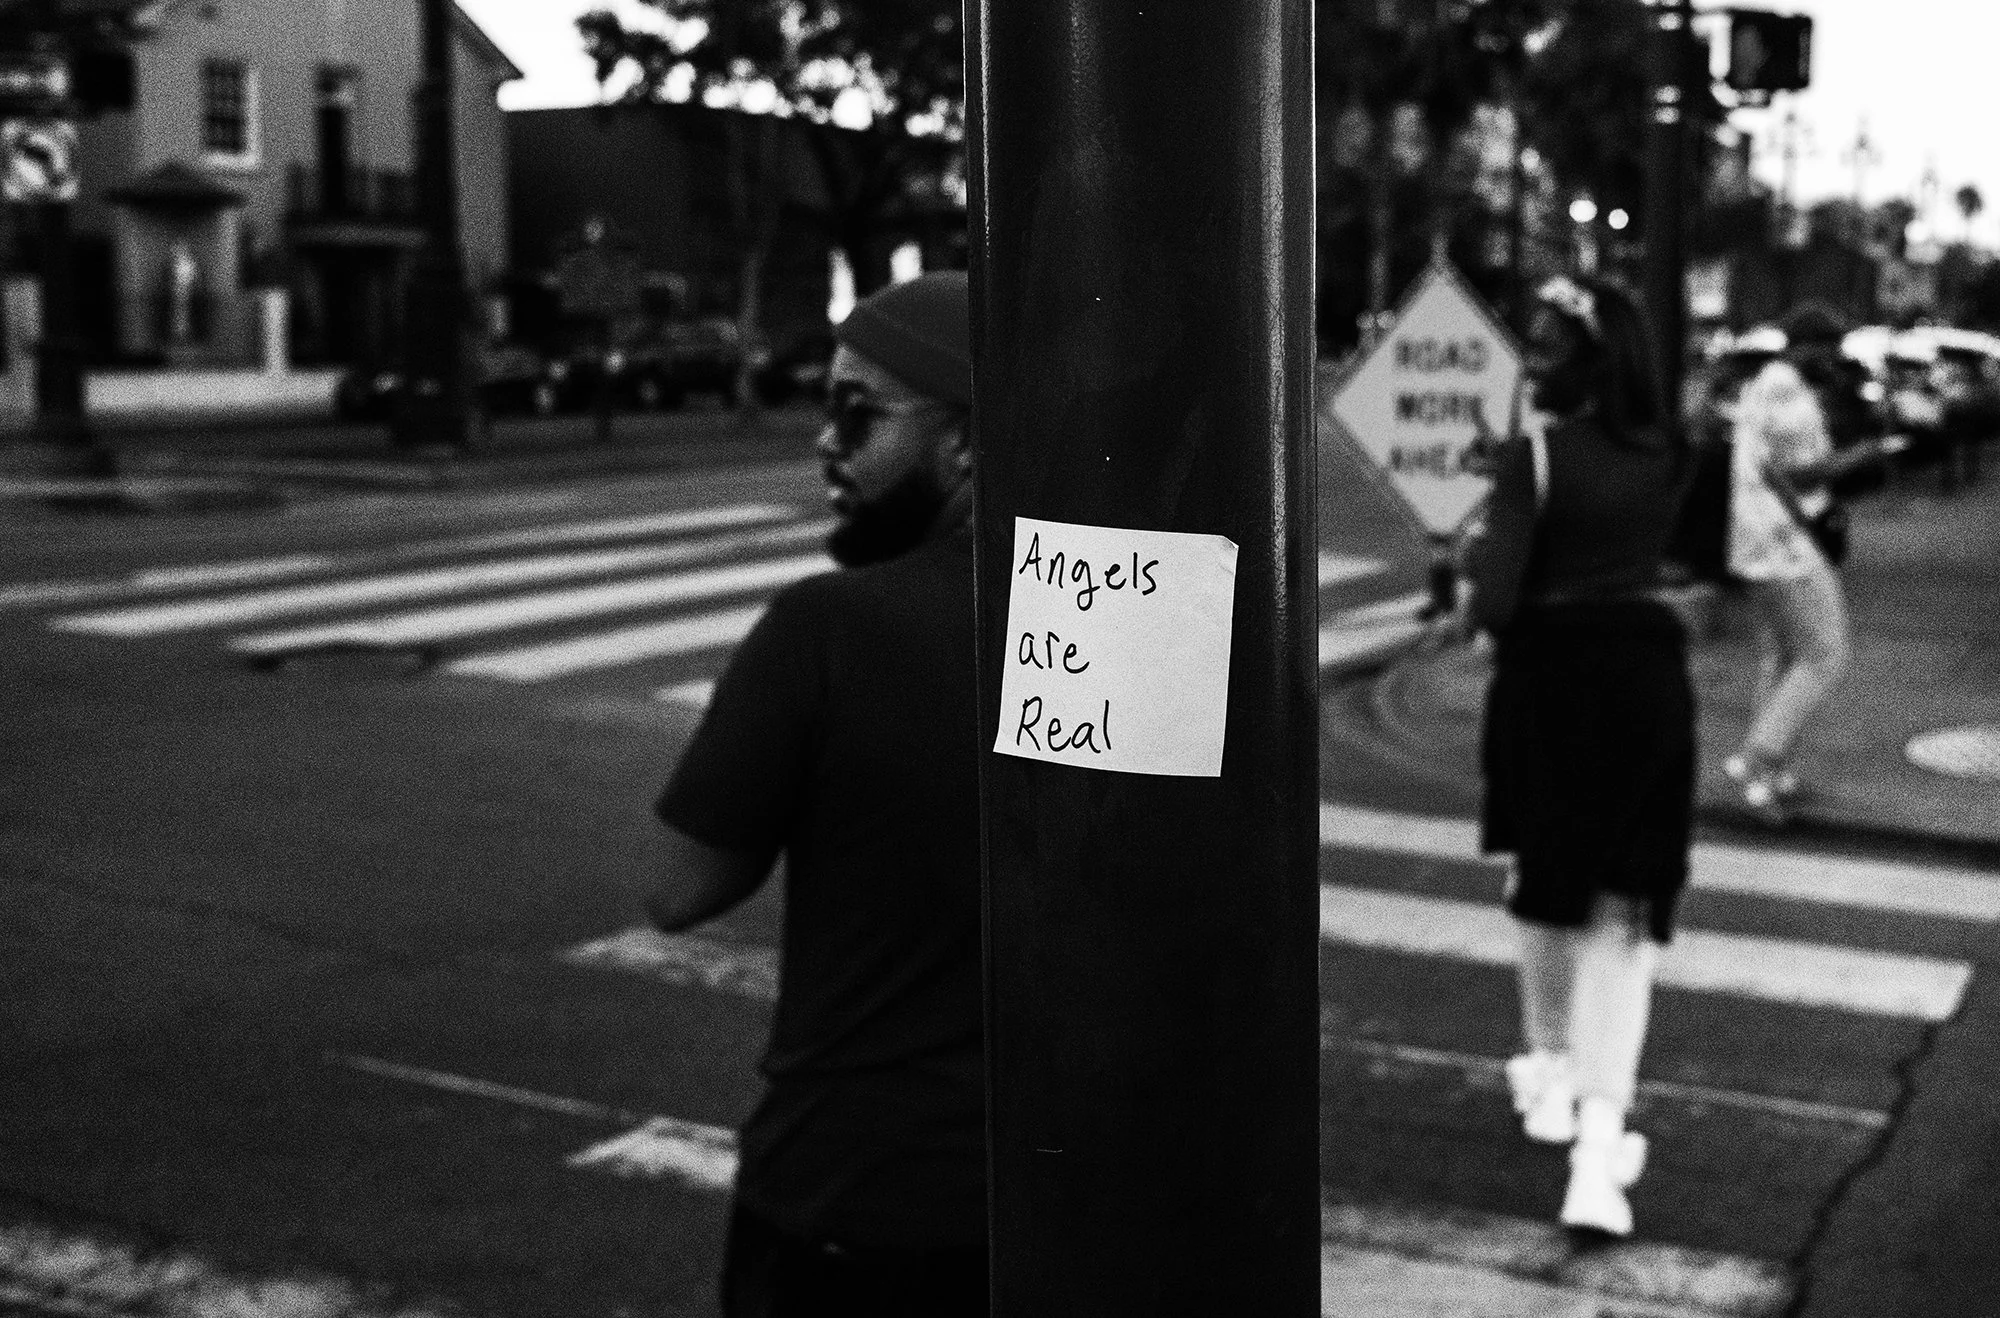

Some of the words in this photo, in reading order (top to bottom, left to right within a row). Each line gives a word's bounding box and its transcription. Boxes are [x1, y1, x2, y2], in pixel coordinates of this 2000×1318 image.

[1394, 337, 1490, 373] ROAD
[1395, 392, 1483, 426] WORK
[1018, 532, 1160, 612] Angels
[1018, 631, 1090, 675] are
[1016, 695, 1112, 754] Real
